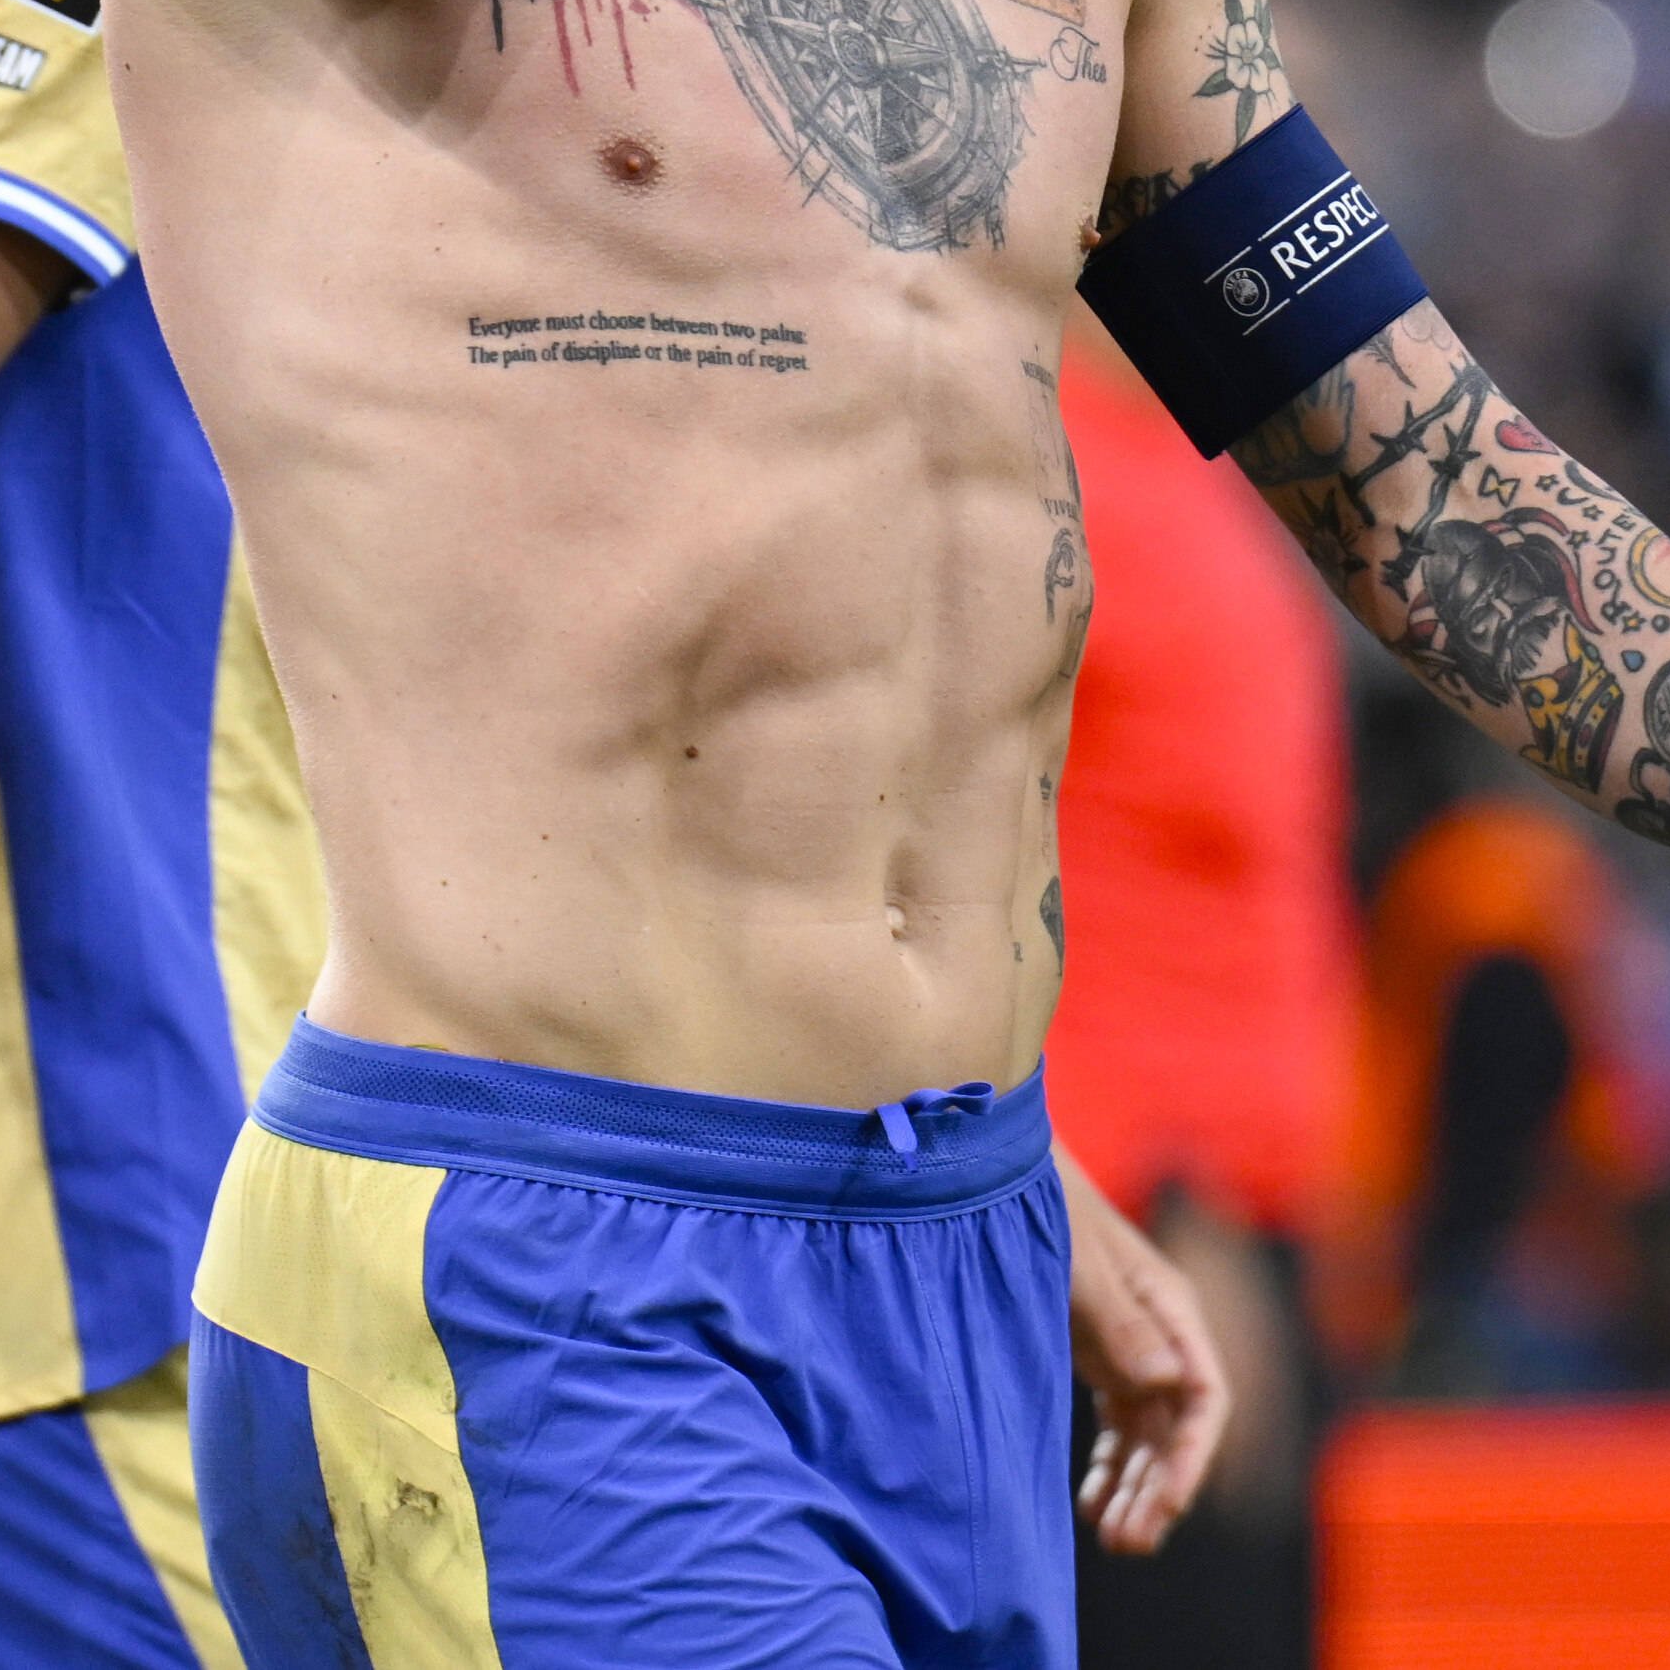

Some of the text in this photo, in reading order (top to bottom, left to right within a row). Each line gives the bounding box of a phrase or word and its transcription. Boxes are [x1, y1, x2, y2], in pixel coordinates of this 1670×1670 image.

[1270, 184, 1380, 280] RESPEC
[468, 316, 541, 338] Everyone
[545, 313, 585, 331] must
[588, 310, 646, 330] choose
[650, 312, 719, 335] between
[721, 321, 756, 339] two
[467, 346, 499, 364] The
[502, 343, 537, 368] pain
[541, 341, 560, 361] of
[562, 340, 641, 365] discipline
[644, 345, 662, 361] or
[667, 343, 692, 362] the
[696, 345, 733, 368] pain
[736, 348, 756, 367] of
